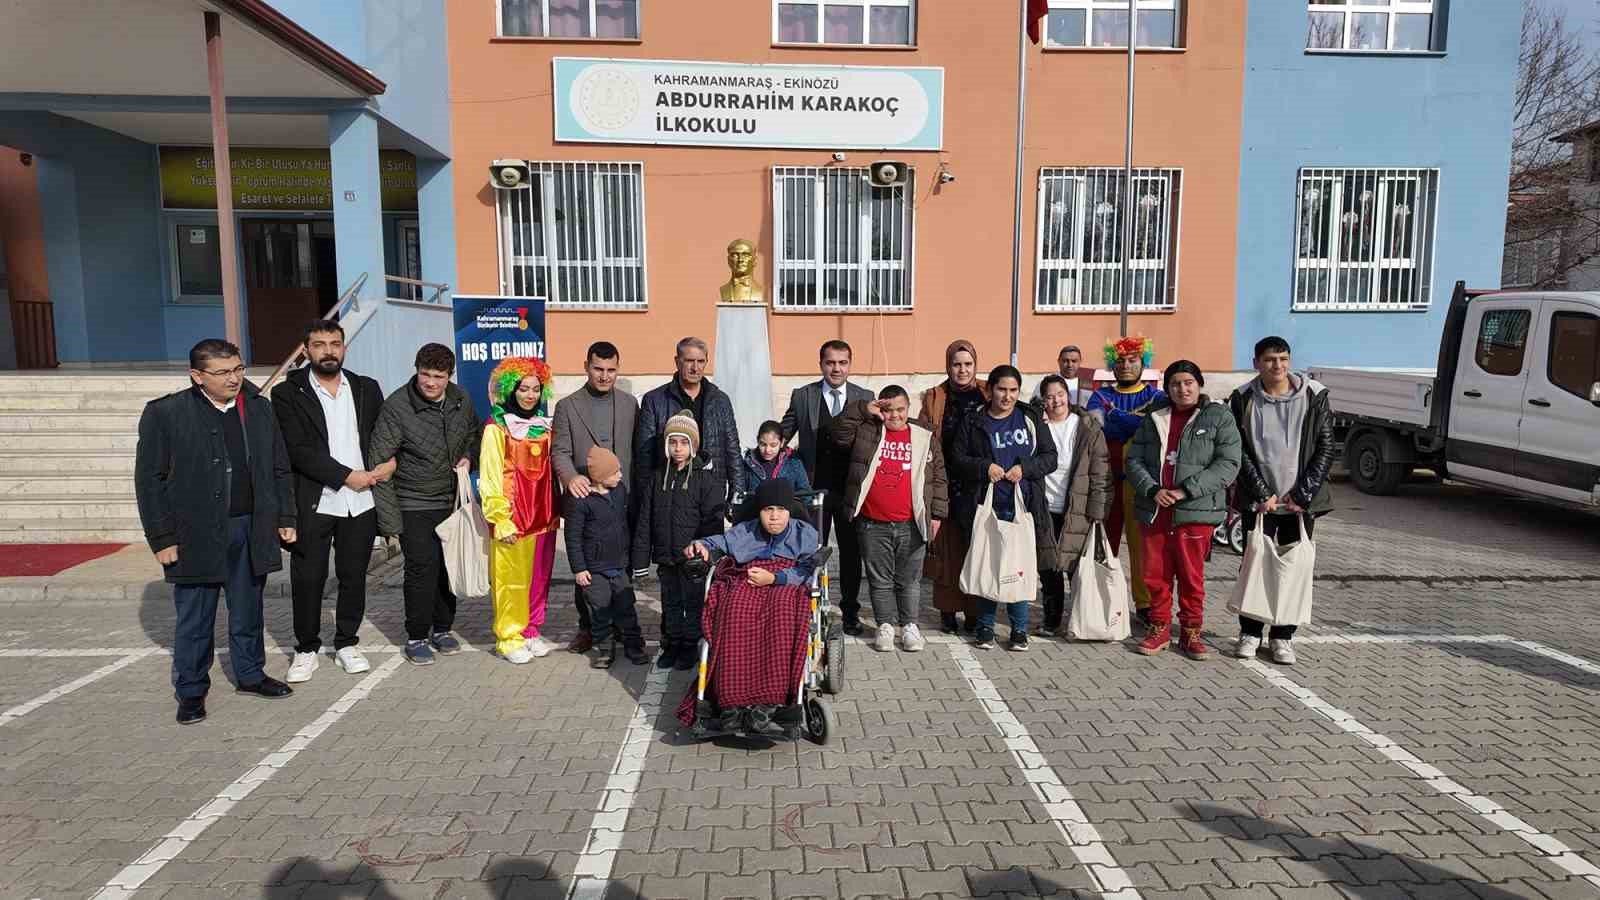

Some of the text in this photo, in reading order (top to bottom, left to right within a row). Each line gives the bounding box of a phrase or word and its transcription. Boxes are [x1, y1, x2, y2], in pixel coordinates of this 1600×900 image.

[654, 74, 773, 89] KAHRAMANMARAŞ
[655, 90, 900, 117] ABDURRAHİM KARAKOÇ
[656, 112, 757, 134] İLKOKULU
[462, 343, 487, 362] HOŞ
[880, 449, 911, 461] ULLS
